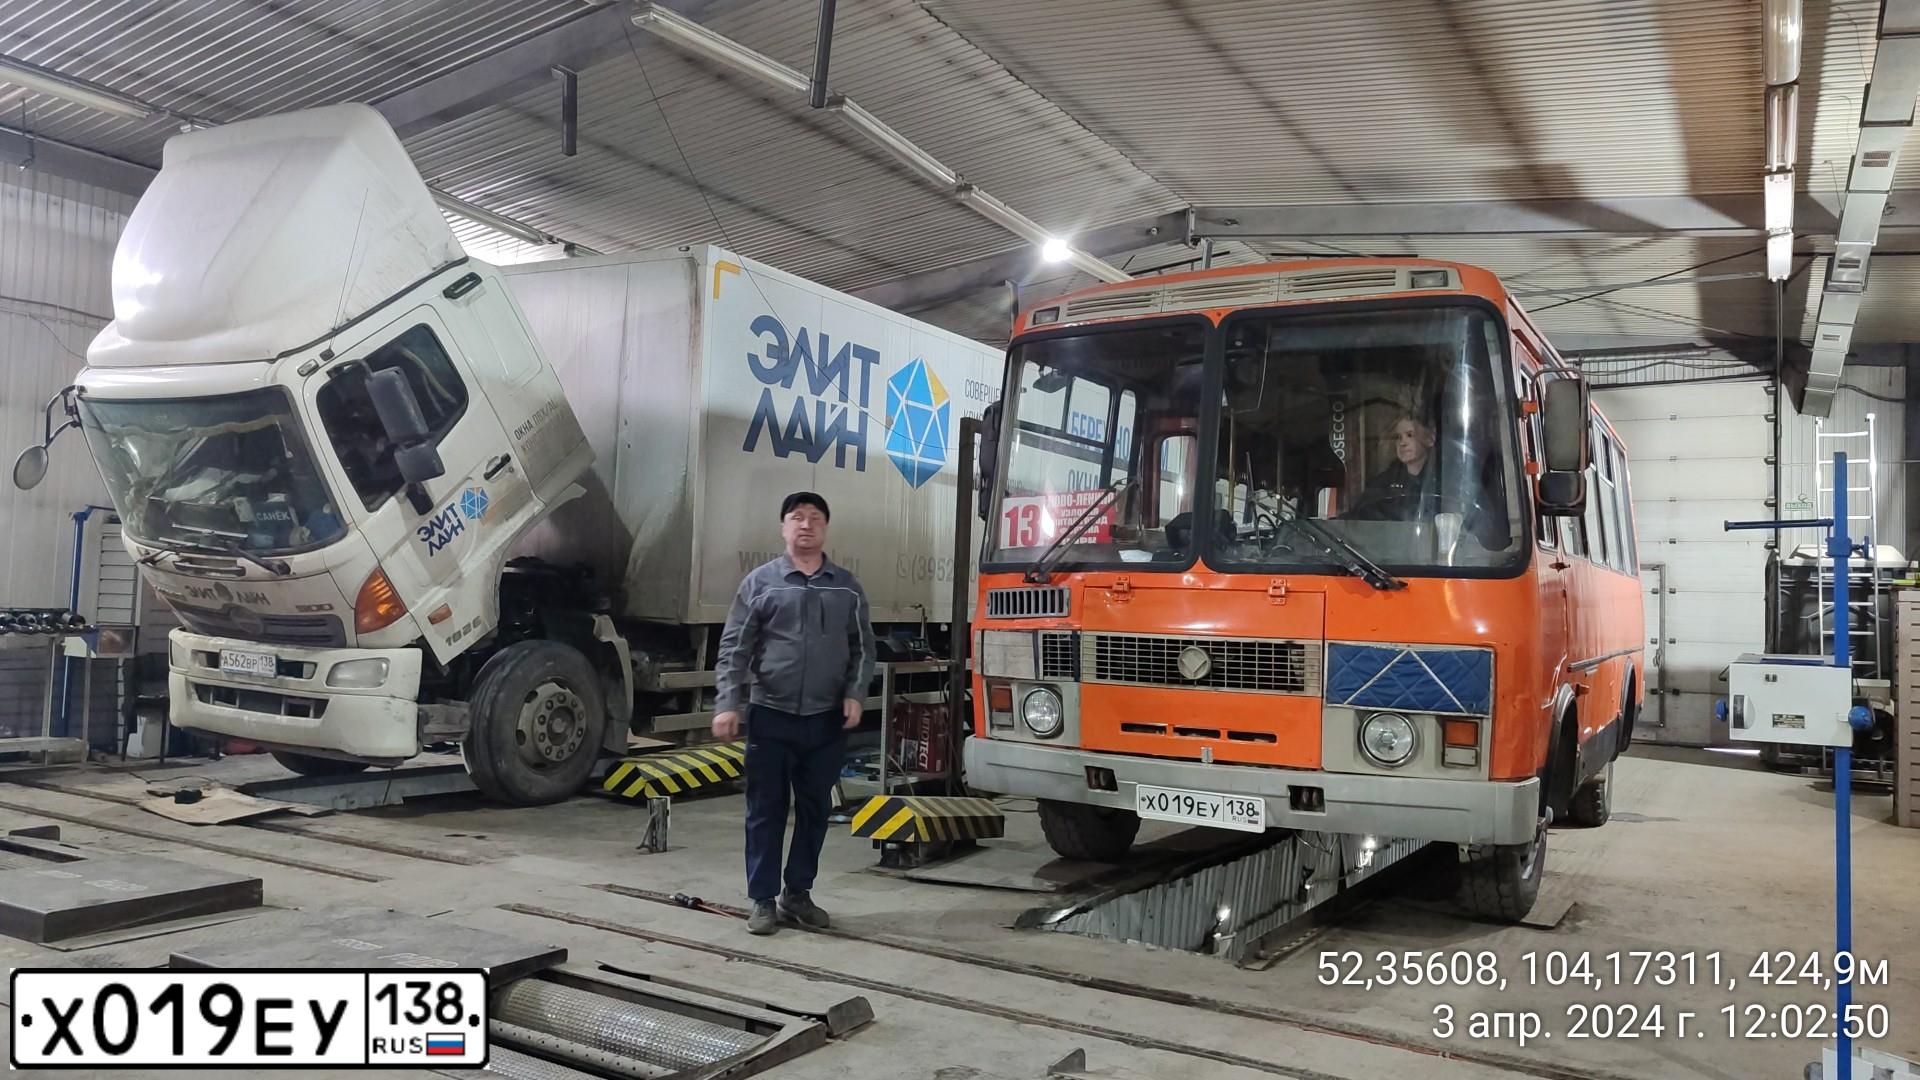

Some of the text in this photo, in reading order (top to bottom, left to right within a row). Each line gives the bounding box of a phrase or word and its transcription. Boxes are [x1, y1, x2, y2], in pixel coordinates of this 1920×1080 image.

[747, 314, 881, 409] ЭЛИТ
[742, 387, 869, 472] ЛАЙН
[417, 503, 460, 542] ЭЛИТ
[428, 519, 465, 557] ЛАЙН
[1004, 504, 1040, 547] 13
[1145, 792, 1256, 818] Х019ЕУ 138
